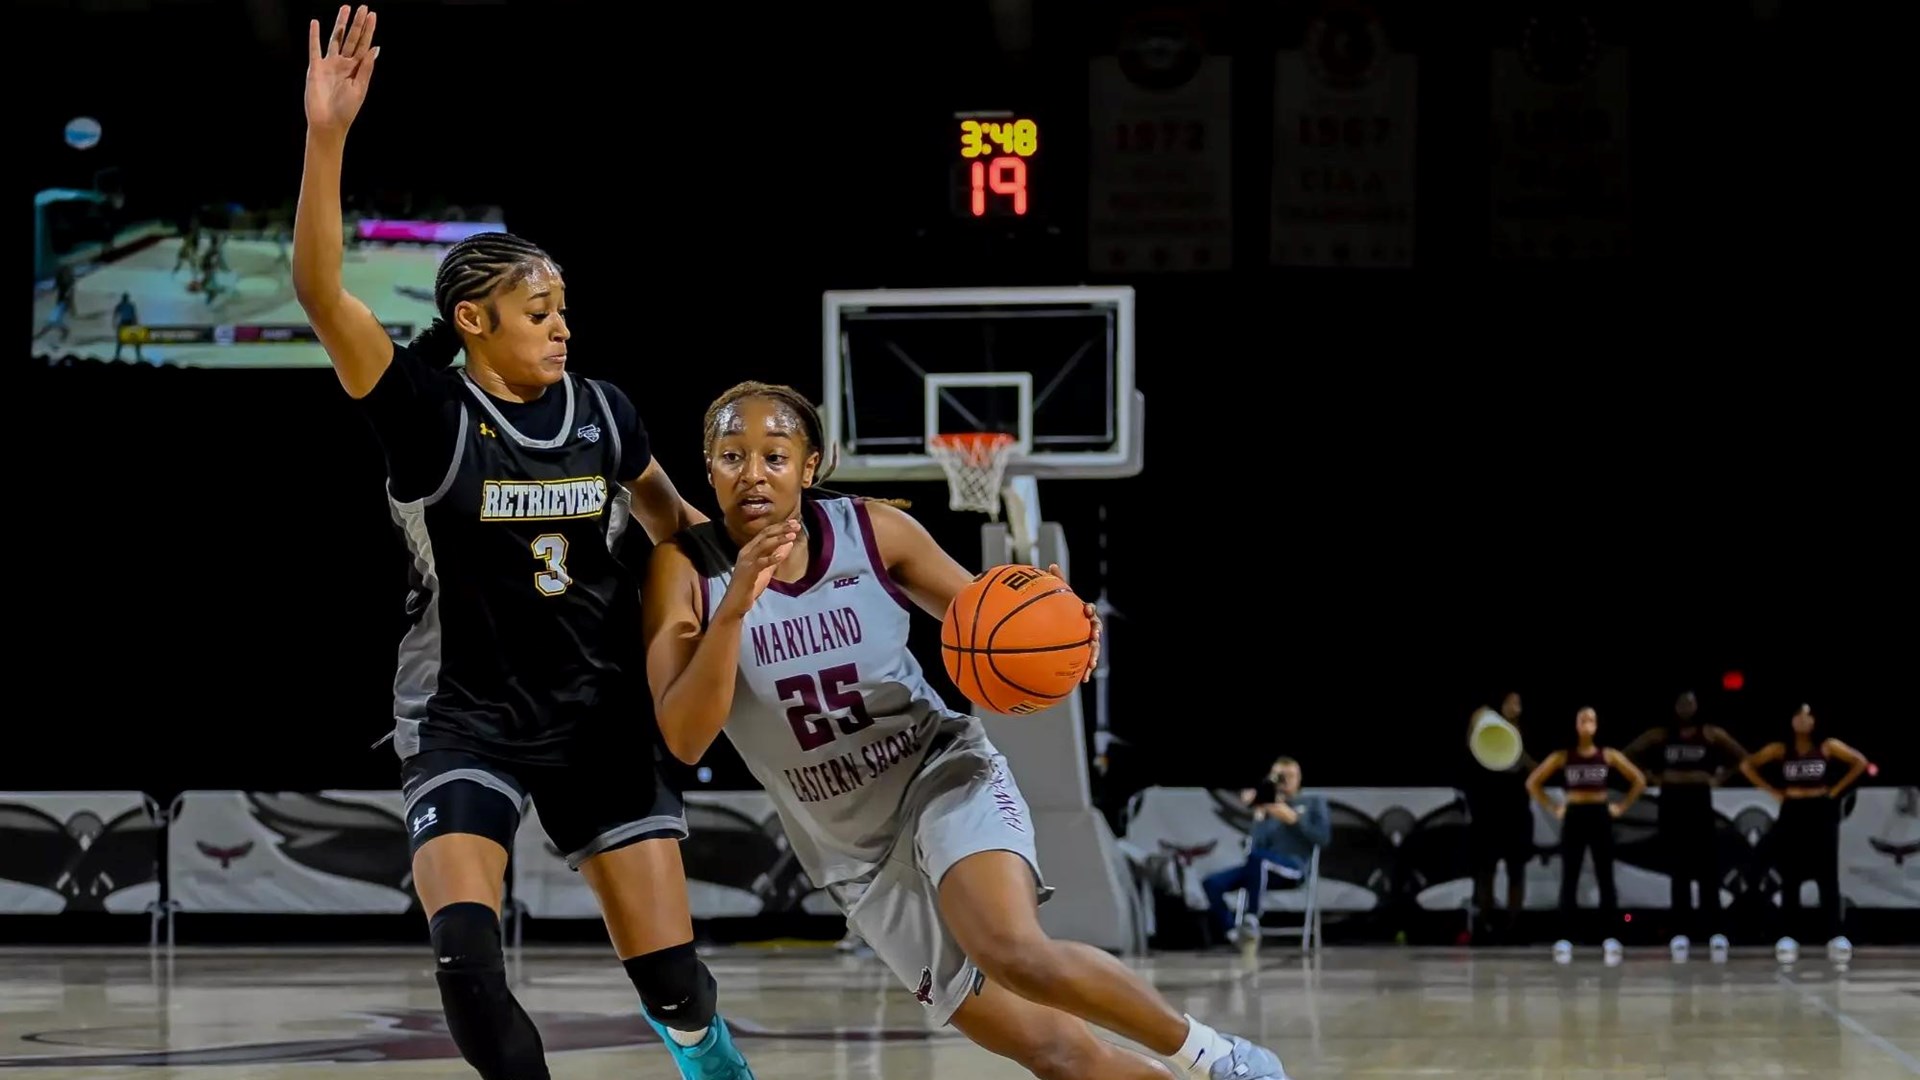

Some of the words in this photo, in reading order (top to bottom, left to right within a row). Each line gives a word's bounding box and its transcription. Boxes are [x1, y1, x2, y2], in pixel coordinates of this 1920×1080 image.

[960, 119, 1037, 158] 3:48
[972, 157, 1027, 216] 19
[480, 475, 608, 521] RETRIEVERS
[531, 533, 573, 597] 3
[751, 606, 863, 667] MARYLAND
[774, 662, 875, 752] 25
[783, 752, 865, 803] EASTERN
[861, 724, 922, 779] SHORE
